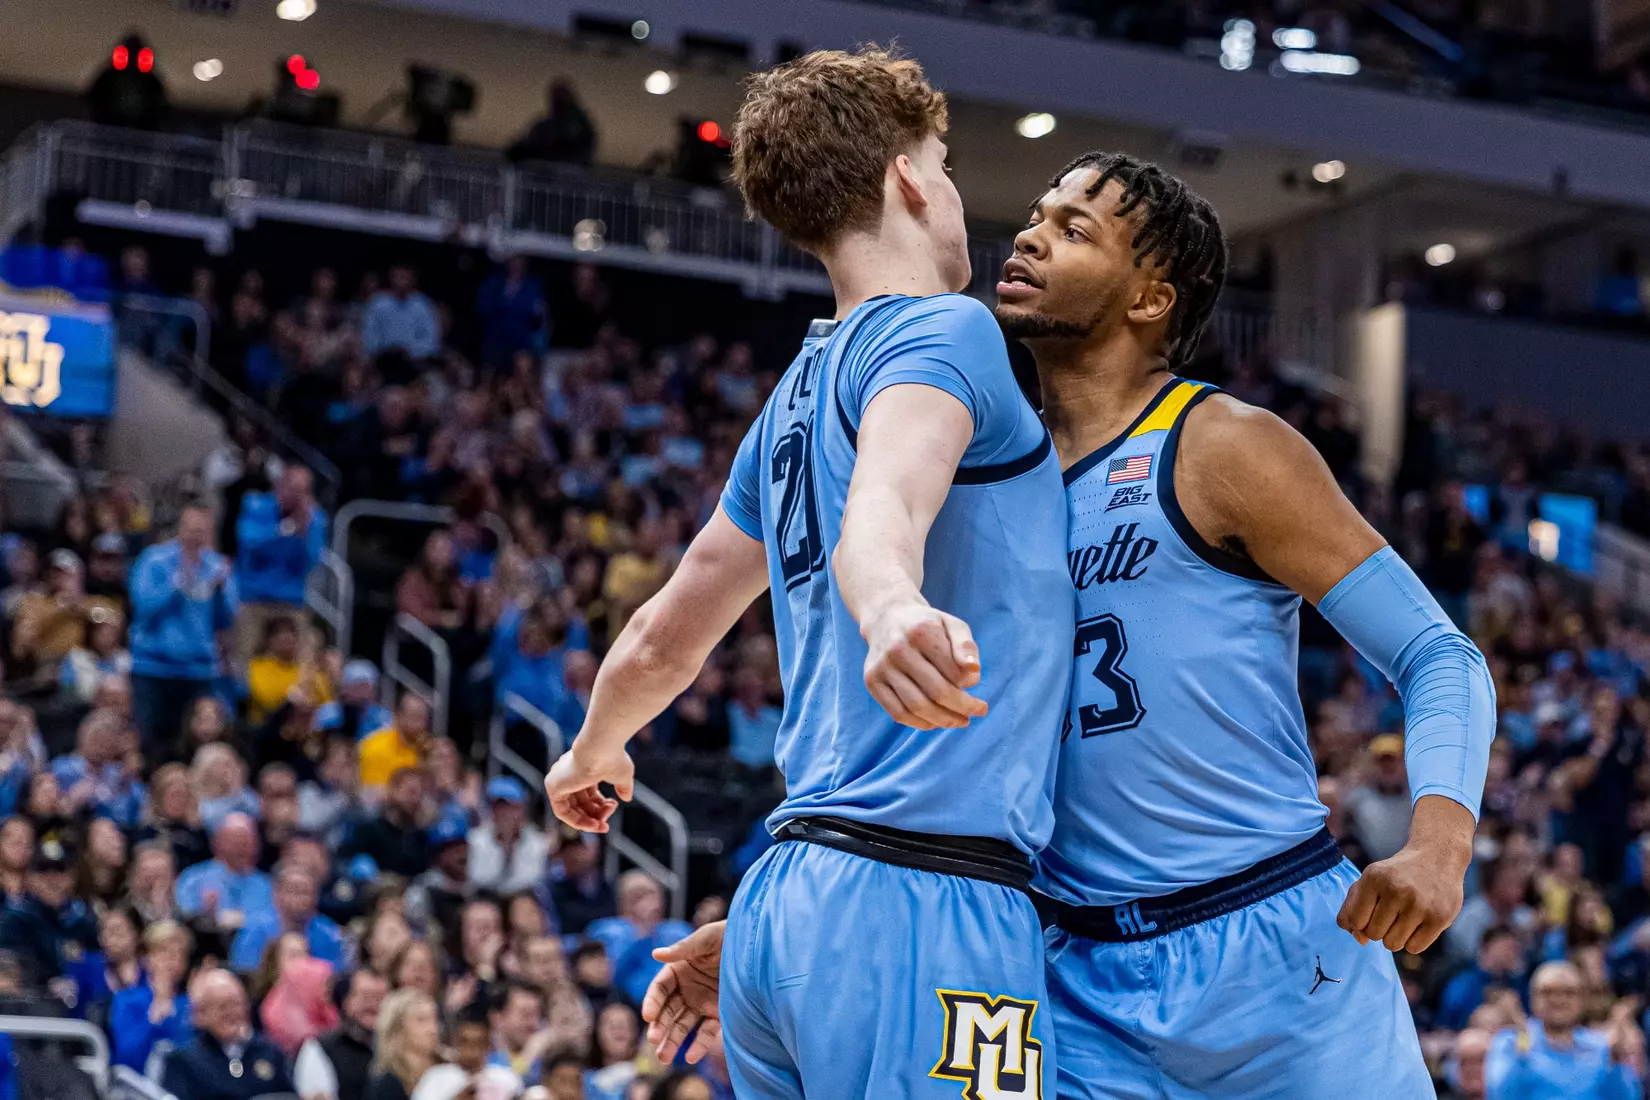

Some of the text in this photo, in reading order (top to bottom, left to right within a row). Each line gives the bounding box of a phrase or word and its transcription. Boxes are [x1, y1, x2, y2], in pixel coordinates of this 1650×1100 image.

[1108, 493, 1152, 507] EAST
[1113, 484, 1145, 498] BIG
[1061, 612, 1147, 743] 3
[928, 988, 1043, 1100] MU
